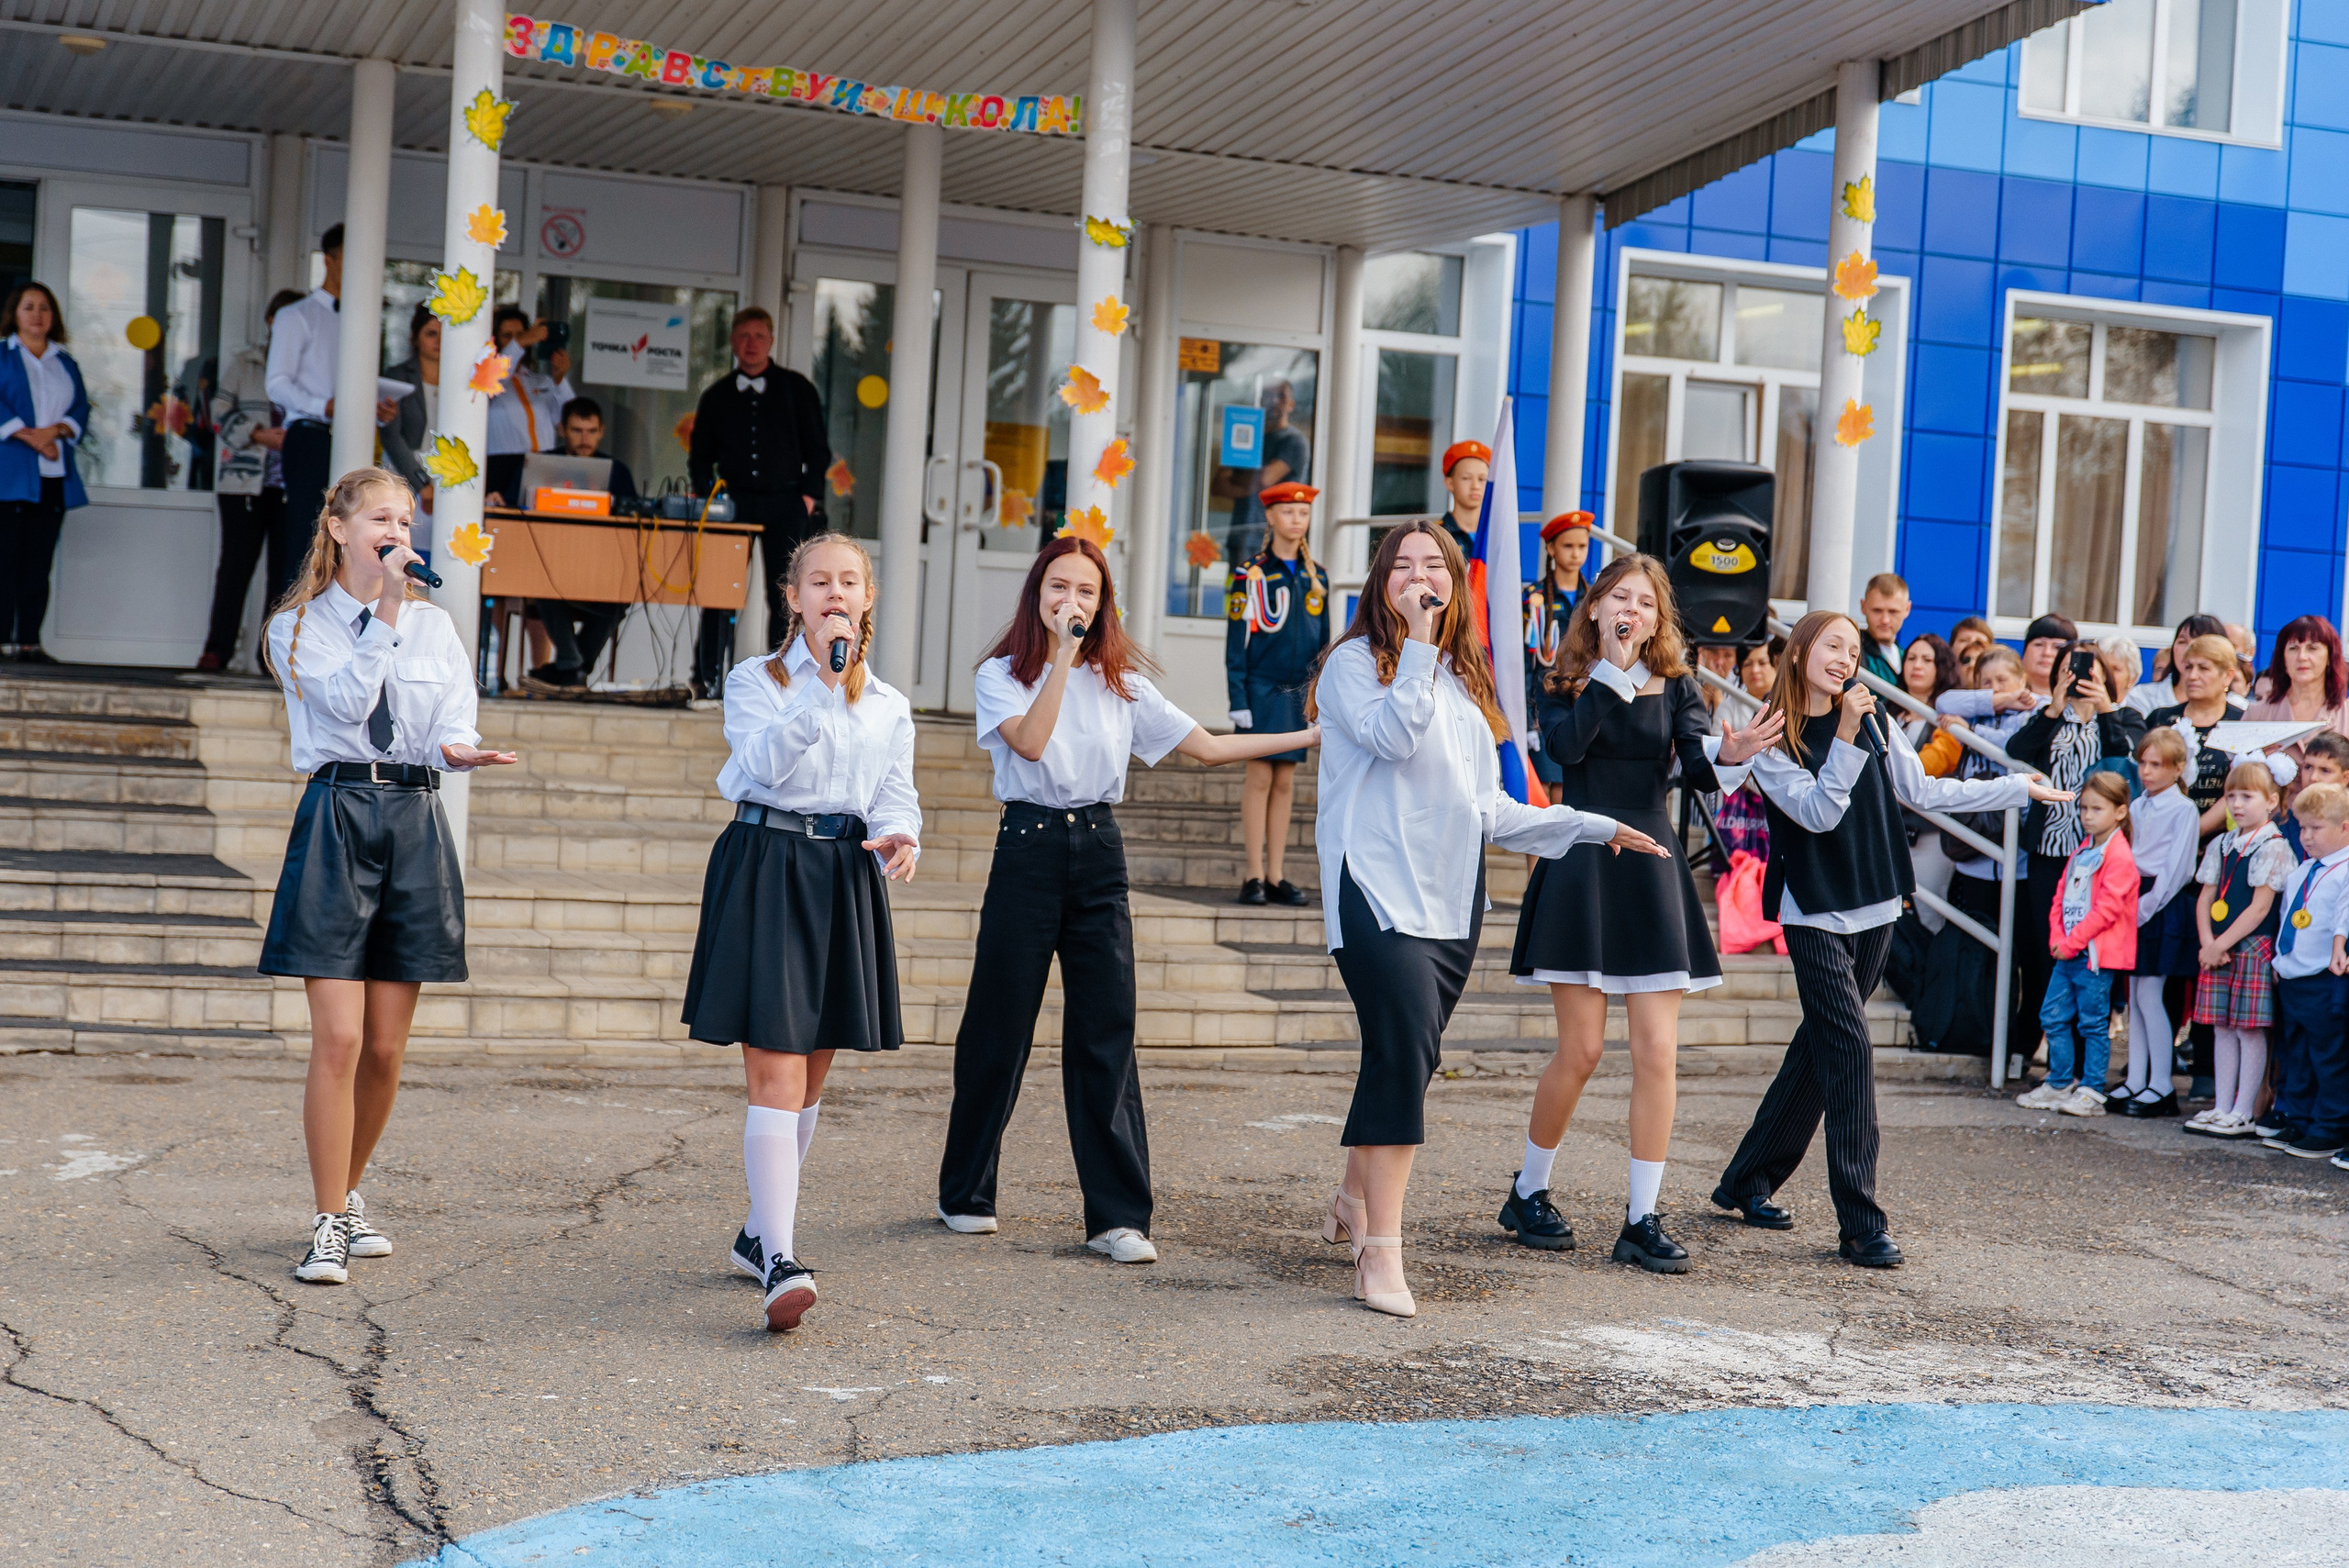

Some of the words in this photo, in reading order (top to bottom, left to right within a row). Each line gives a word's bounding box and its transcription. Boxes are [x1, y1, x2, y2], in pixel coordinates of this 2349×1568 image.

[891, 88, 1082, 133] ШКОЛА!
[647, 347, 682, 357] РОСТА
[1710, 555, 1739, 567] 1500
